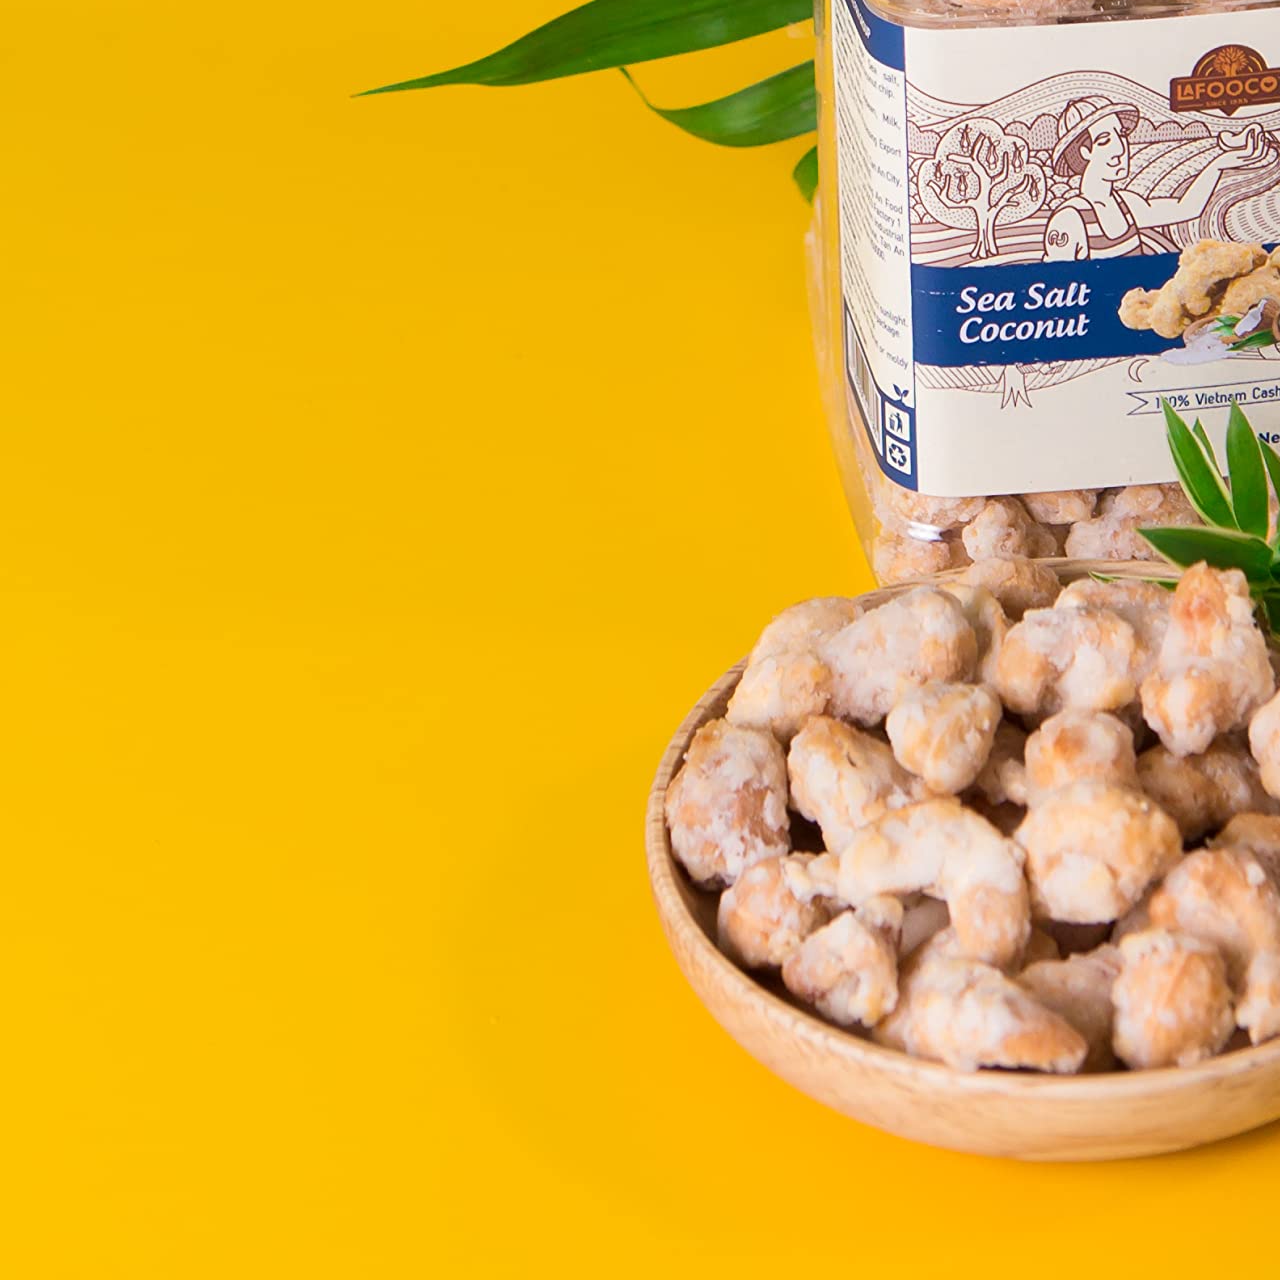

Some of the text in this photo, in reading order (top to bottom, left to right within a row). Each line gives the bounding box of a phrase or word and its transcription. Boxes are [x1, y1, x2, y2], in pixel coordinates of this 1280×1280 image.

[1177, 76, 1278, 100] LAFOOCO
[956, 282, 1091, 313] Sea Salt
[959, 314, 1090, 344] Coconut
[1155, 395, 1190, 409] 10%
[1195, 391, 1247, 406] Vietnam
